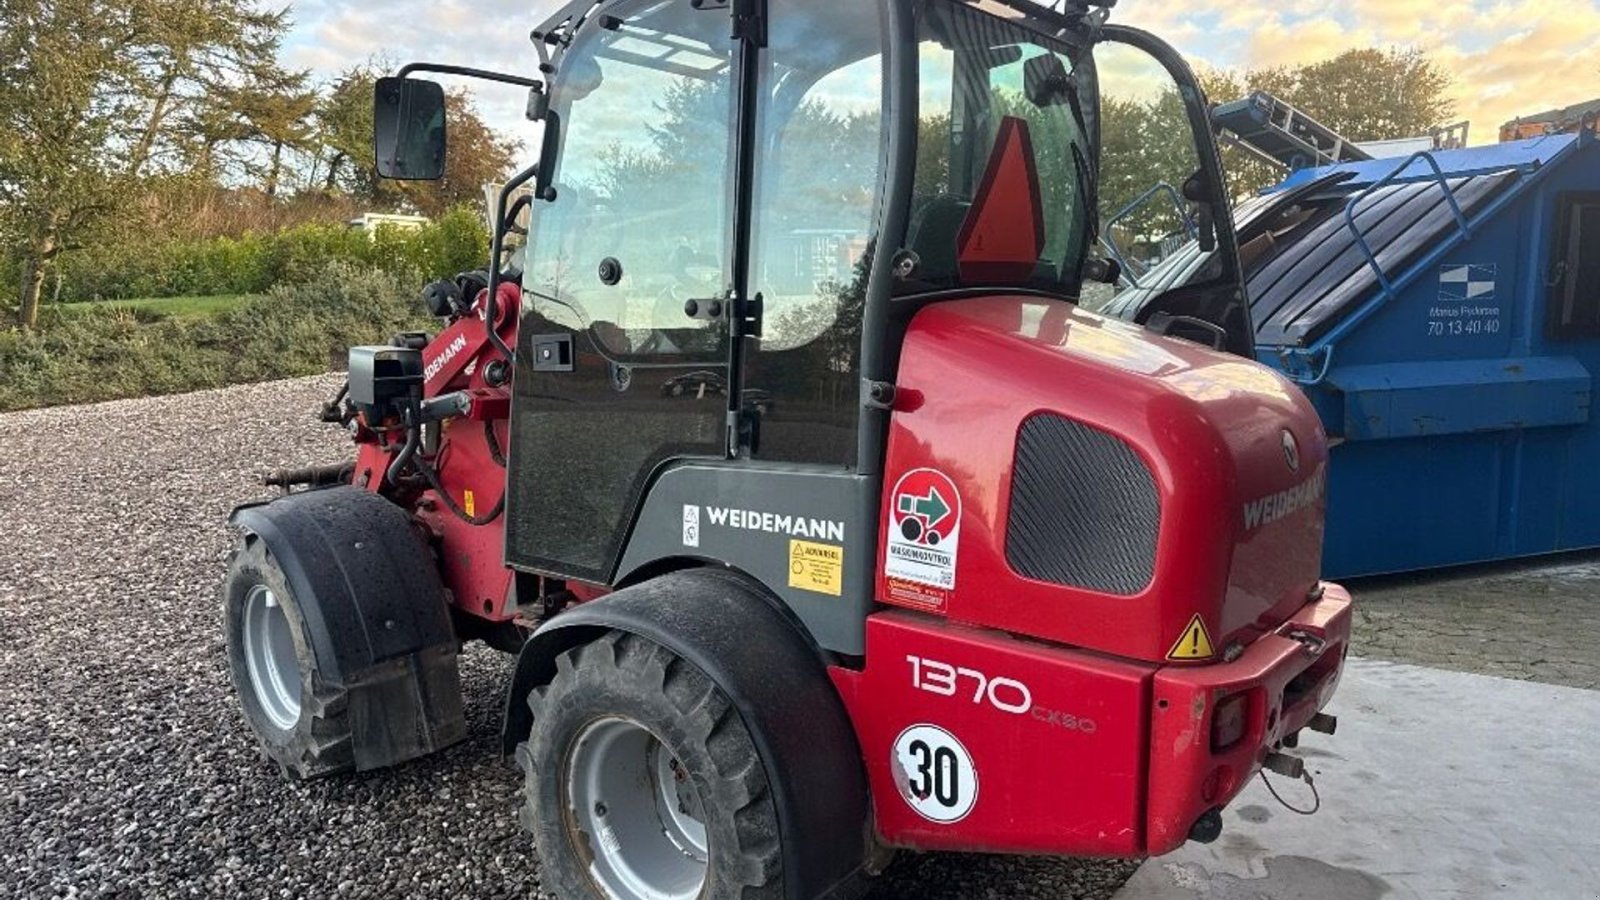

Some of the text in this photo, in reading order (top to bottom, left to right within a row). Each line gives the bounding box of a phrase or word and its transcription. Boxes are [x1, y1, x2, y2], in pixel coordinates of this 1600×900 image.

[1428, 319, 1499, 335] 70 13 40 40
[706, 506, 844, 541] WEIDEMANN
[906, 655, 1032, 714] 1370
[909, 739, 959, 807] 30
